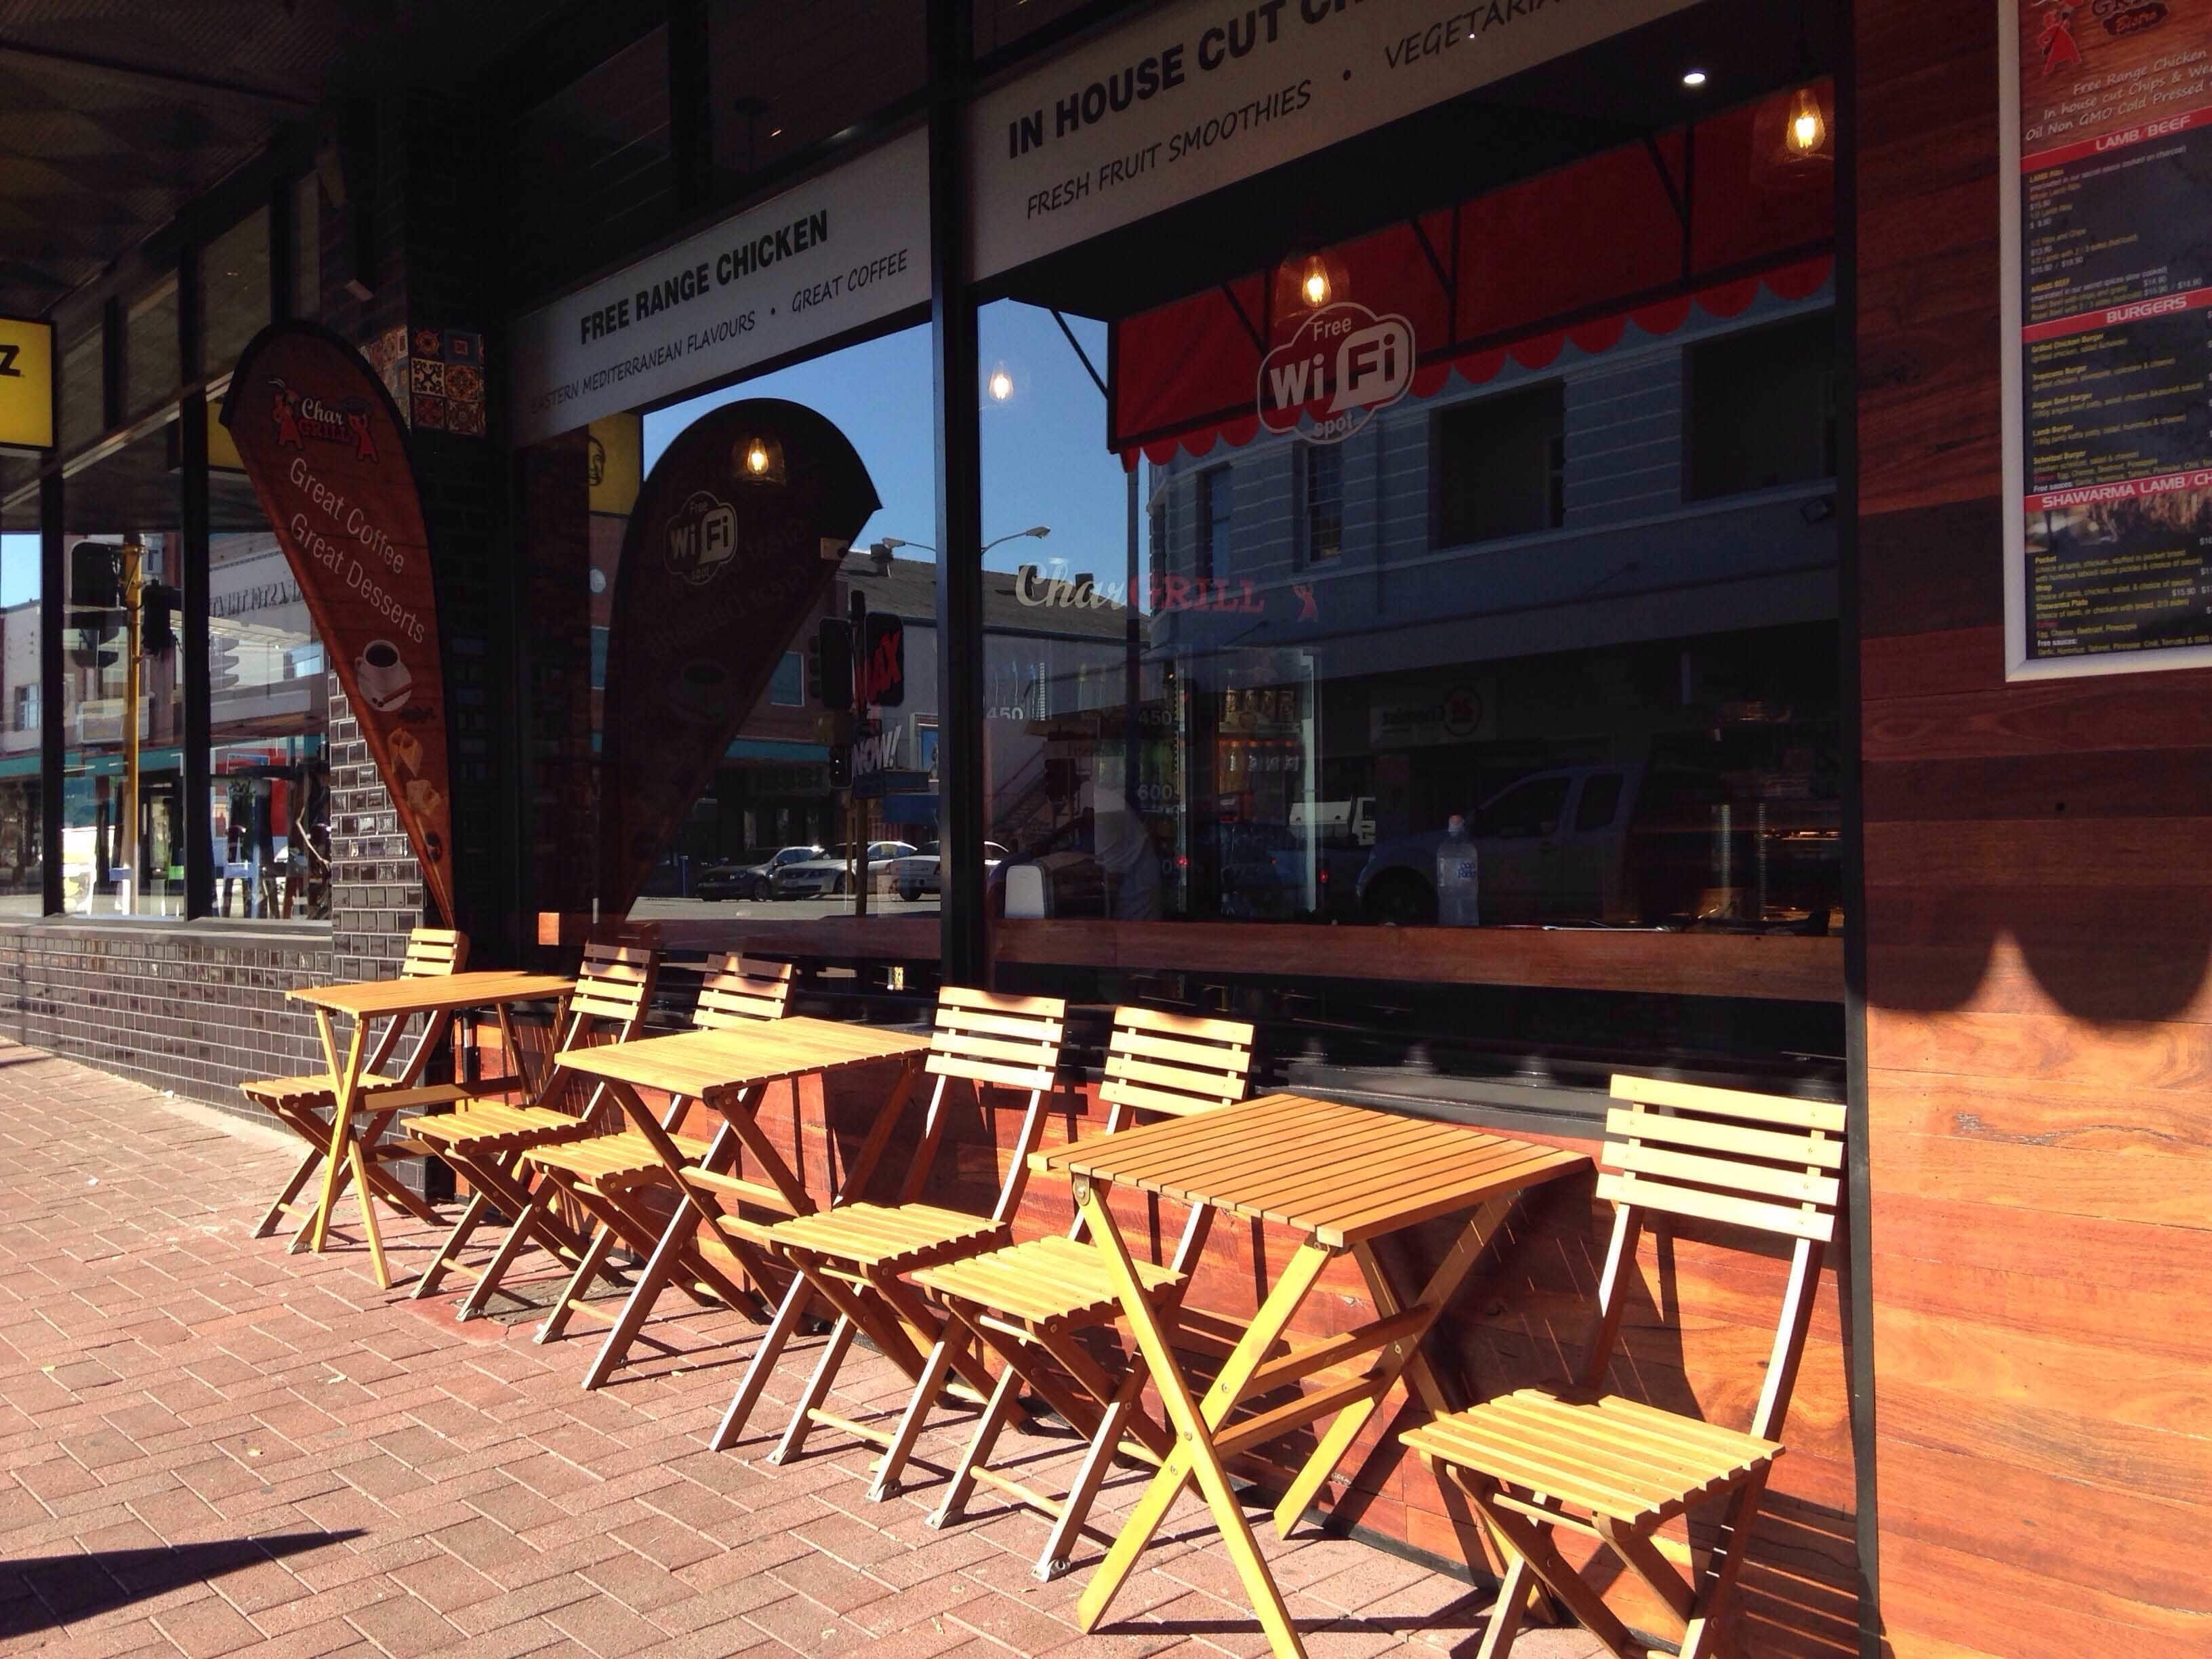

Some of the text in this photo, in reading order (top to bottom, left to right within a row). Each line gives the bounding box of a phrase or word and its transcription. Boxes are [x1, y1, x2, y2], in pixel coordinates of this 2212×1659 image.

[1008, 108, 1043, 159] IN
[1055, 43, 1185, 138] HOUSE
[1197, 0, 1286, 71] CUT
[2061, 97, 2098, 115] house
[2102, 88, 2124, 103] cut
[2129, 77, 2166, 95] Chips
[2072, 50, 2207, 96] Free Range Chicken
[2025, 78, 2205, 141] Oil Non GMO Cold Pressed
[2095, 115, 2192, 151] LAMB BEEF
[1026, 79, 1312, 220] FRESH FRUIT SMOOTHIES
[580, 209, 829, 345] FREE RANGE CHICKEN
[792, 248, 908, 314] GREAT COFFEE
[1312, 317, 1352, 341] Free
[2106, 295, 2188, 324] BURGERS
[582, 341, 683, 394] MEDITERRANEAN
[687, 310, 756, 354] FLAVOURS
[302, 396, 344, 426] Char
[1313, 410, 1353, 441] spot
[290, 457, 345, 522] Great
[2041, 484, 2136, 508] SHAWARMA
[2140, 476, 2186, 494] LAMB
[291, 513, 344, 575] Great
[347, 508, 405, 575] Coffee
[346, 560, 425, 644] Desserts
[1016, 558, 1266, 614] Char GRILL
